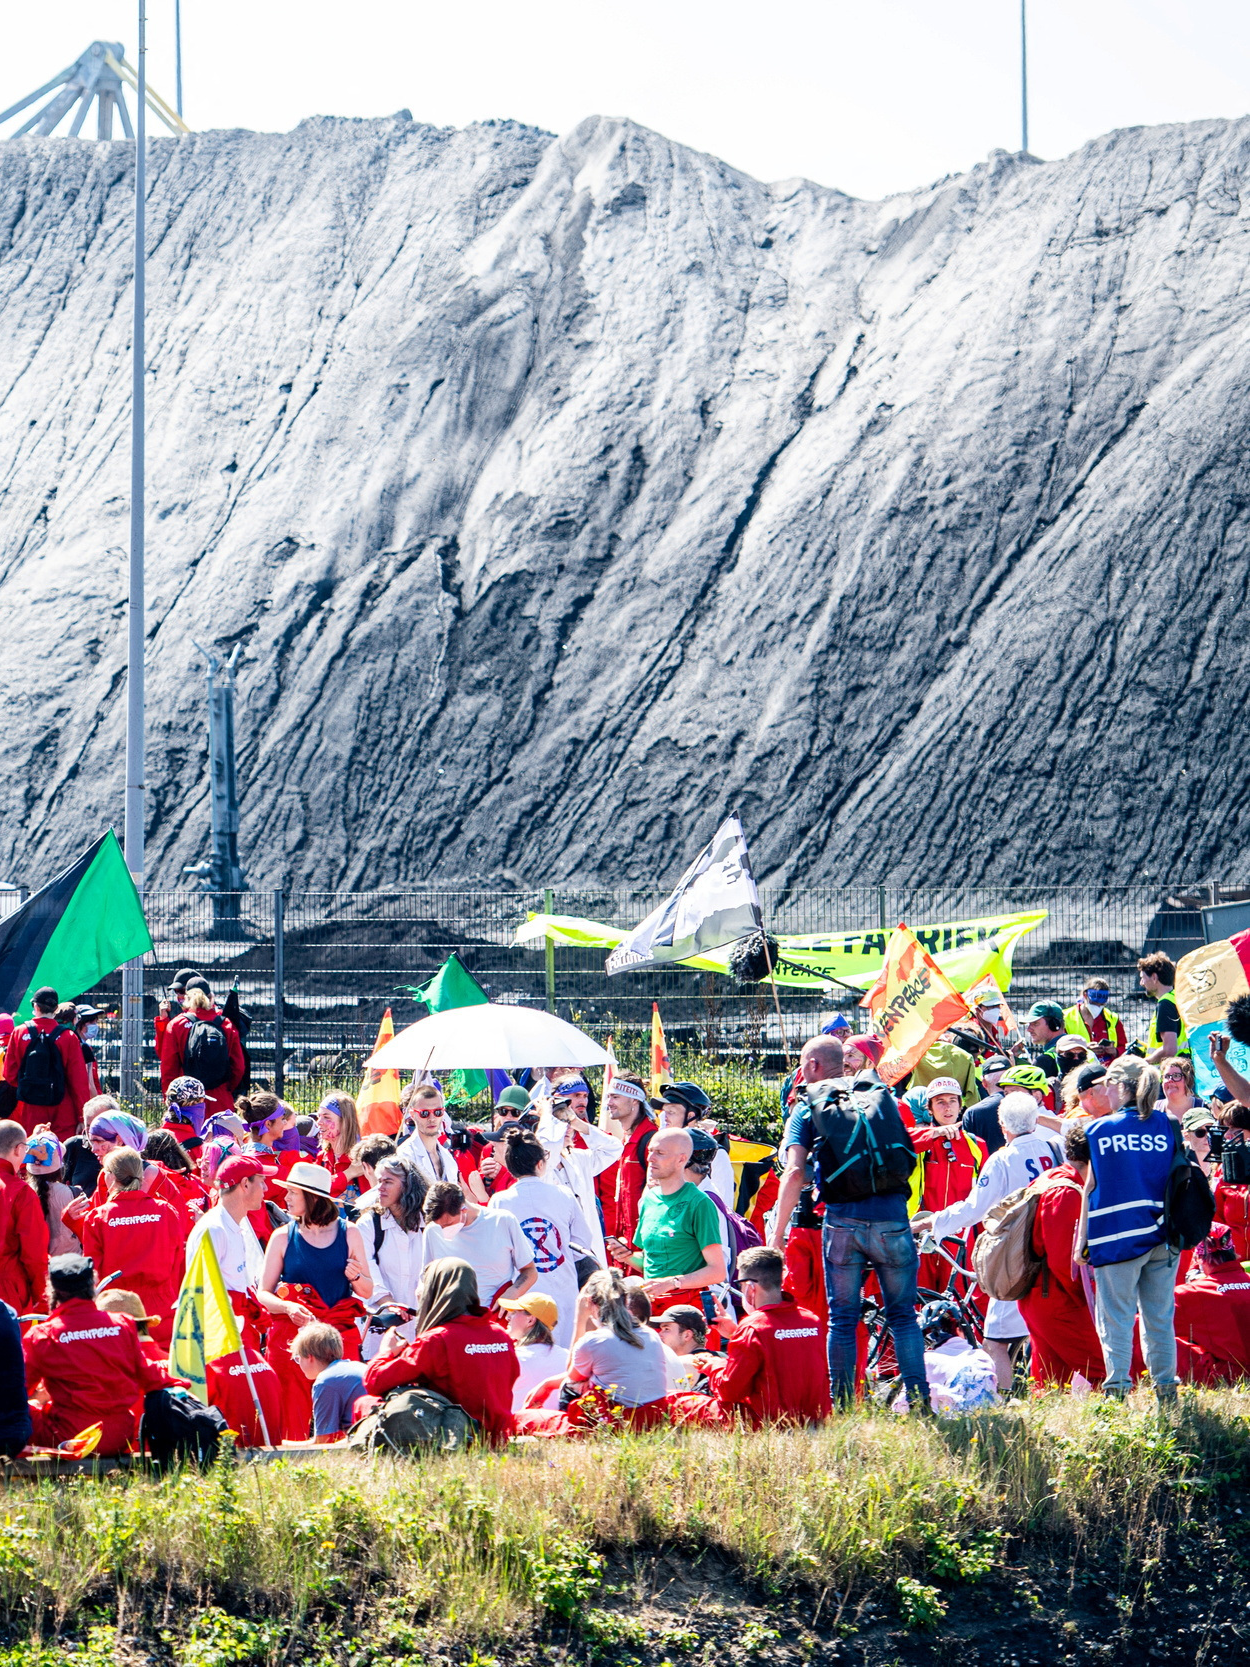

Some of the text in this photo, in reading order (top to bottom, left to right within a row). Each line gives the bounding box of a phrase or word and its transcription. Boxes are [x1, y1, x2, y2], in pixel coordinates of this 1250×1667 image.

[843, 926, 1001, 955] FARIEK
[773, 961, 837, 978] NPEACE
[1098, 1134, 1168, 1155] PRESS
[108, 1214, 161, 1227] GREENPEACE
[59, 1326, 121, 1343] GREENPEACE
[774, 1327, 818, 1340] GREENPEACE
[464, 1342, 508, 1355] GREENPEACE
